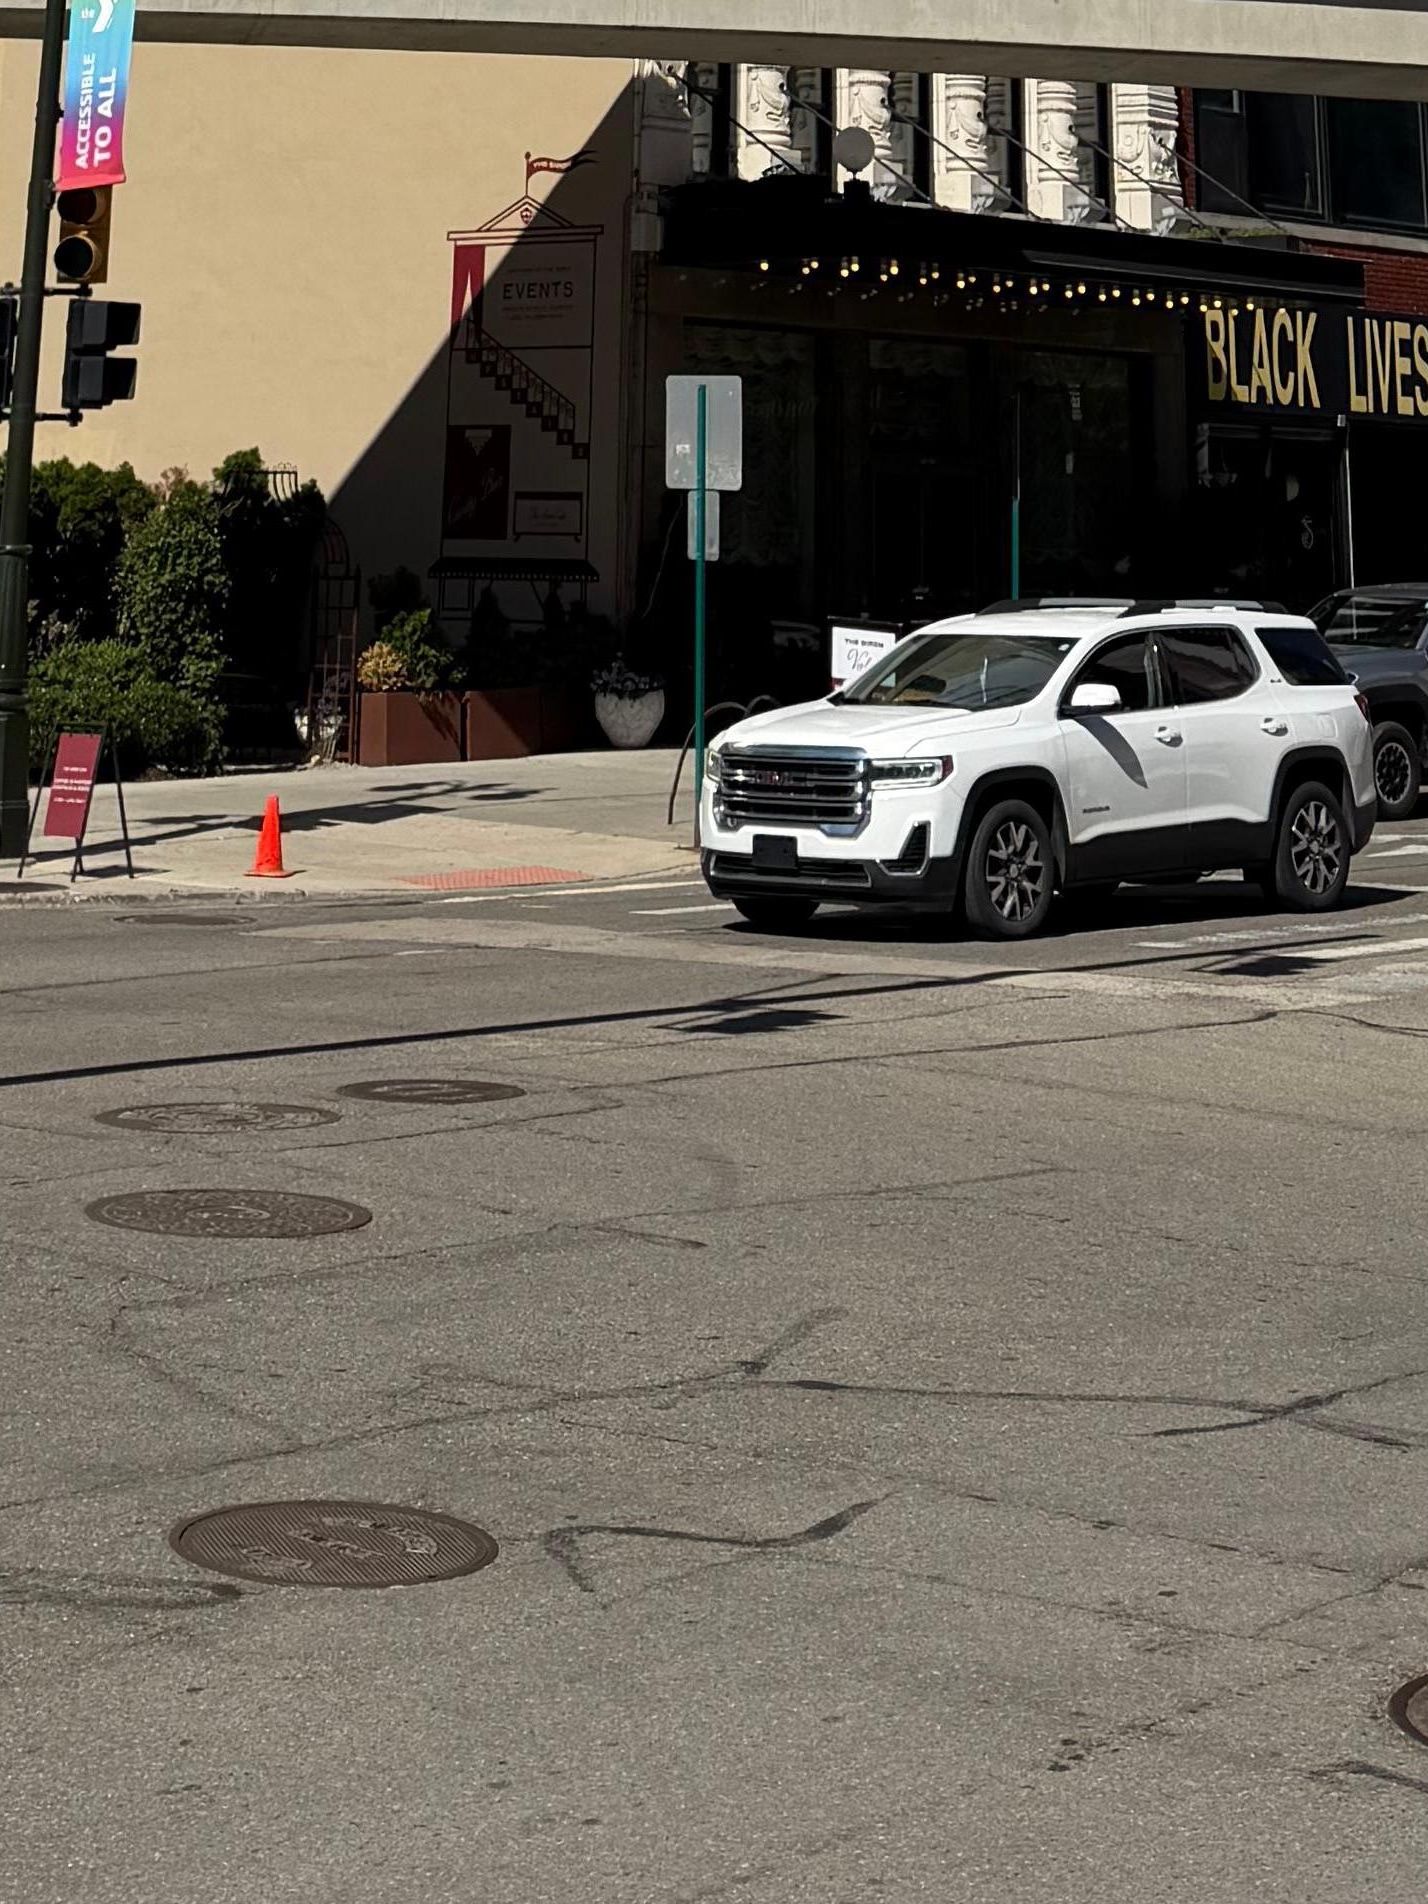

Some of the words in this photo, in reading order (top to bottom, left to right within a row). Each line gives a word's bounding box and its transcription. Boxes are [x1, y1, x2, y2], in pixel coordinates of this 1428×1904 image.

[75, 53, 96, 170] ACCESSIBLE
[97, 67, 117, 119] ALL
[94, 125, 113, 168] TO
[503, 281, 574, 300] EVENTS
[1205, 308, 1321, 409] BLACK
